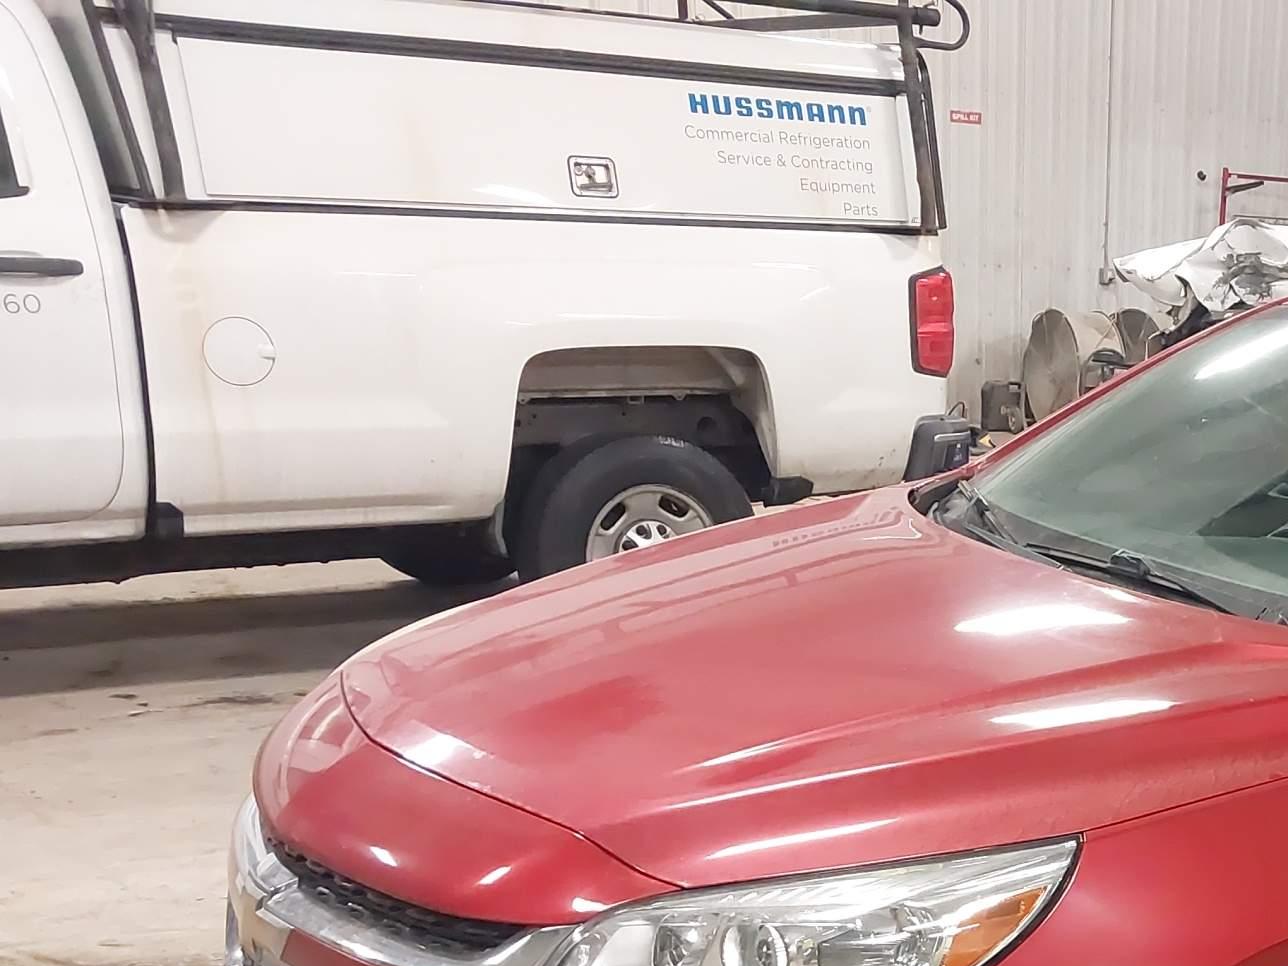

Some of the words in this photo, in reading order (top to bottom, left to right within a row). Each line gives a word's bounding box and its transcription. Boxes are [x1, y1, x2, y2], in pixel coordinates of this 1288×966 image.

[688, 93, 867, 126] HUSSMANN
[684, 125, 774, 144] Commercial
[779, 131, 871, 150] Refrigeration
[717, 151, 772, 166] Service
[776, 154, 787, 168] &
[791, 155, 873, 174] Contracting
[800, 178, 876, 195] Equipment
[843, 203, 879, 217] Parts
[3, 293, 41, 314] 60
